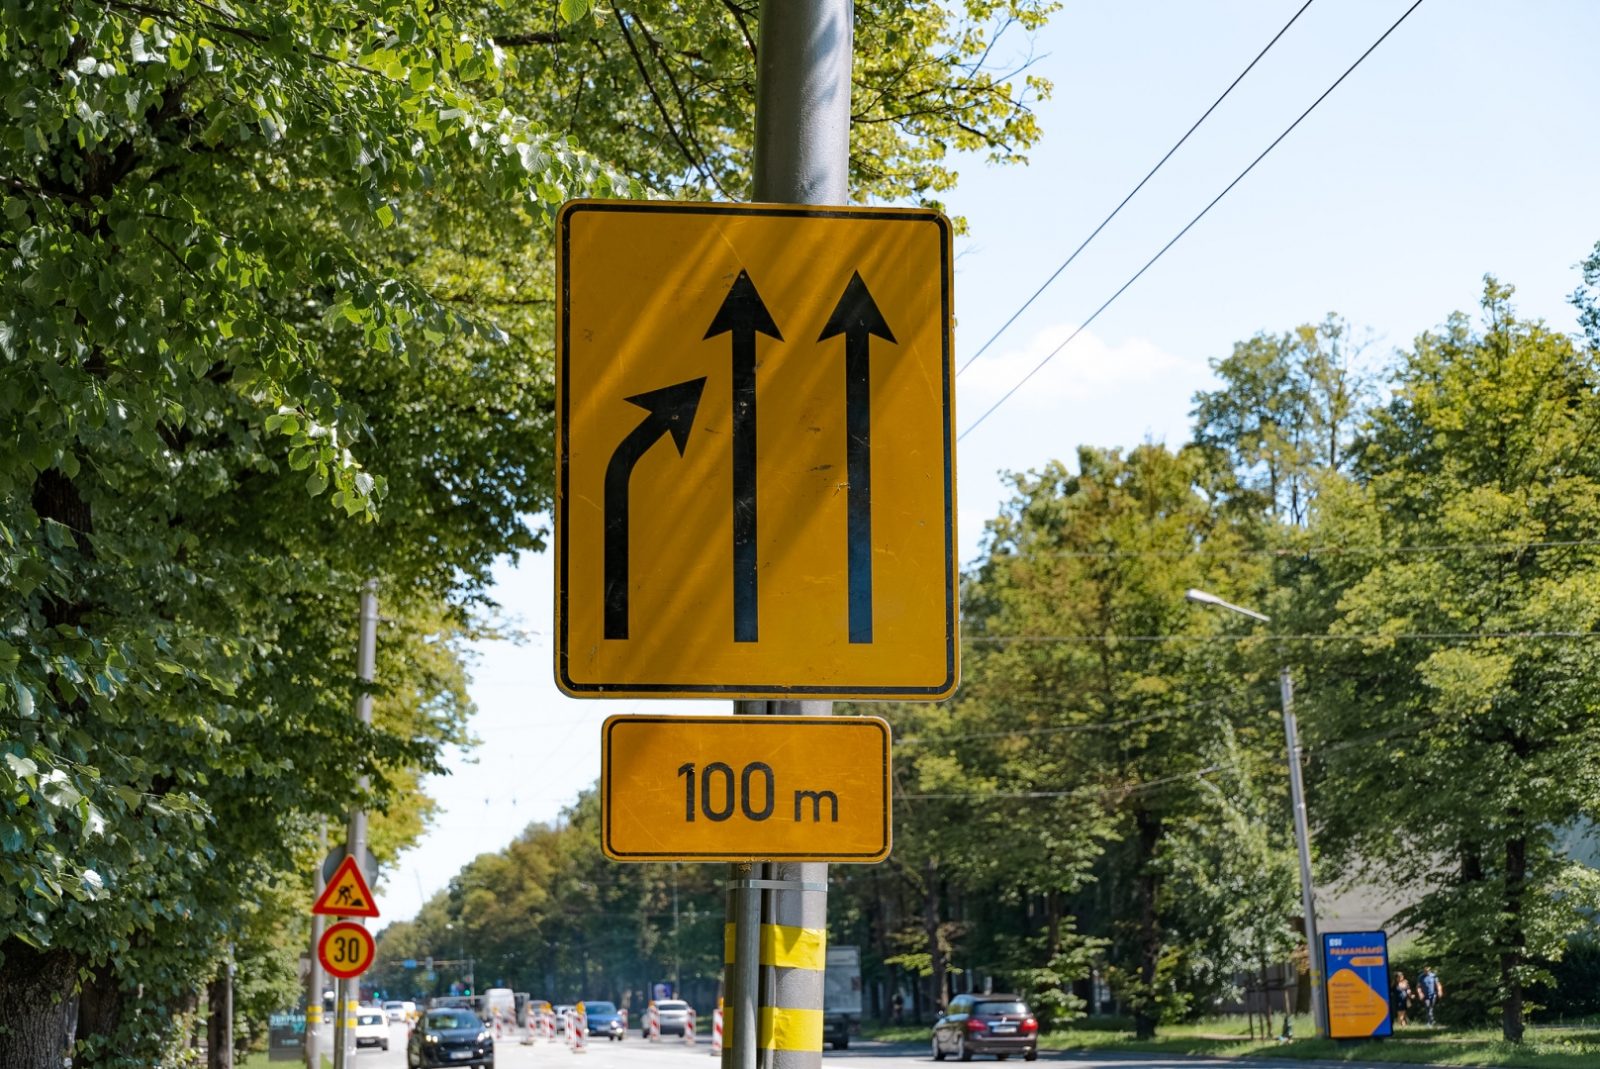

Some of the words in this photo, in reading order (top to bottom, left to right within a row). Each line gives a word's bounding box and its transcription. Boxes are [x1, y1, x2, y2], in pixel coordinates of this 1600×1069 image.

[677, 761, 775, 823] 100
[794, 790, 839, 823] m
[333, 936, 360, 964] 30
